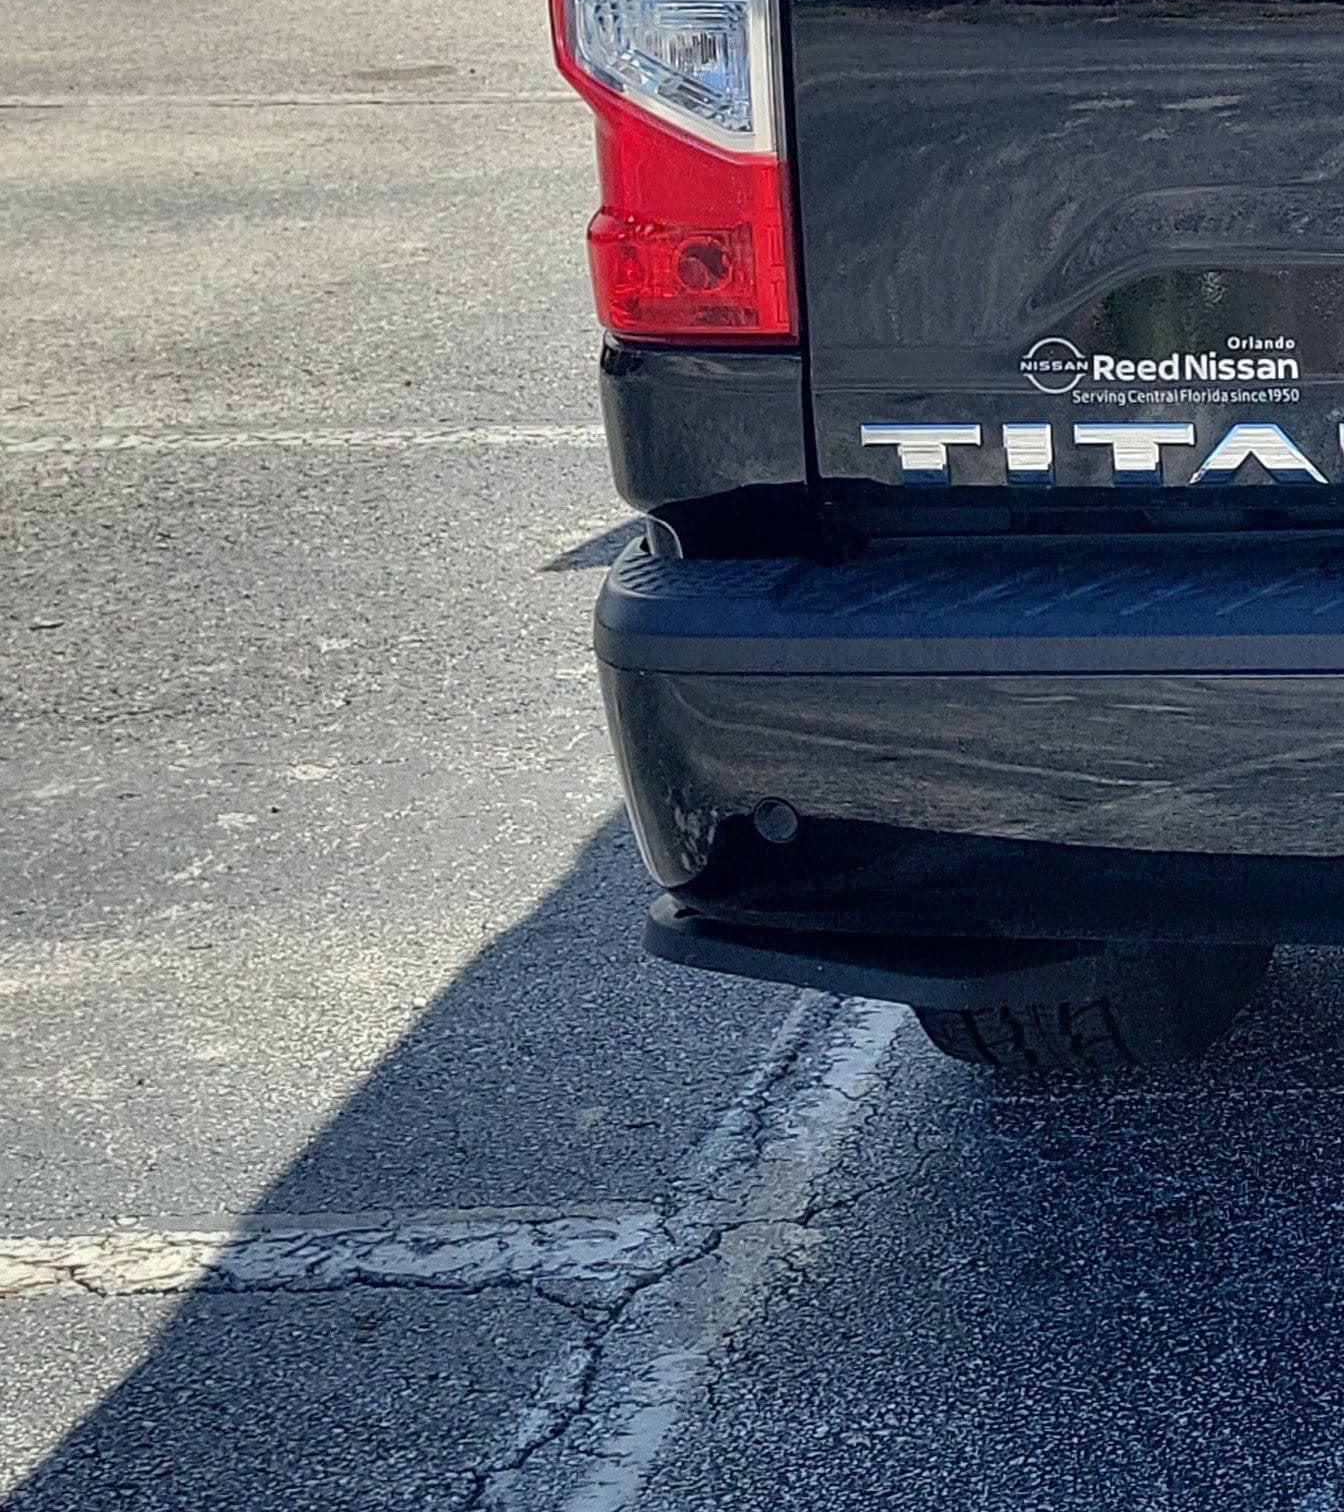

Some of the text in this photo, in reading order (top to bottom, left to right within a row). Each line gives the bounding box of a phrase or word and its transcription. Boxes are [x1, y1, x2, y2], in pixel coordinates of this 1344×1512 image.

[1227, 336, 1296, 350] Orlando
[1020, 360, 1089, 372] NISSAN
[1093, 351, 1299, 381] Reed Nissan
[1072, 389, 1300, 406] Serving Central Florida since 1950
